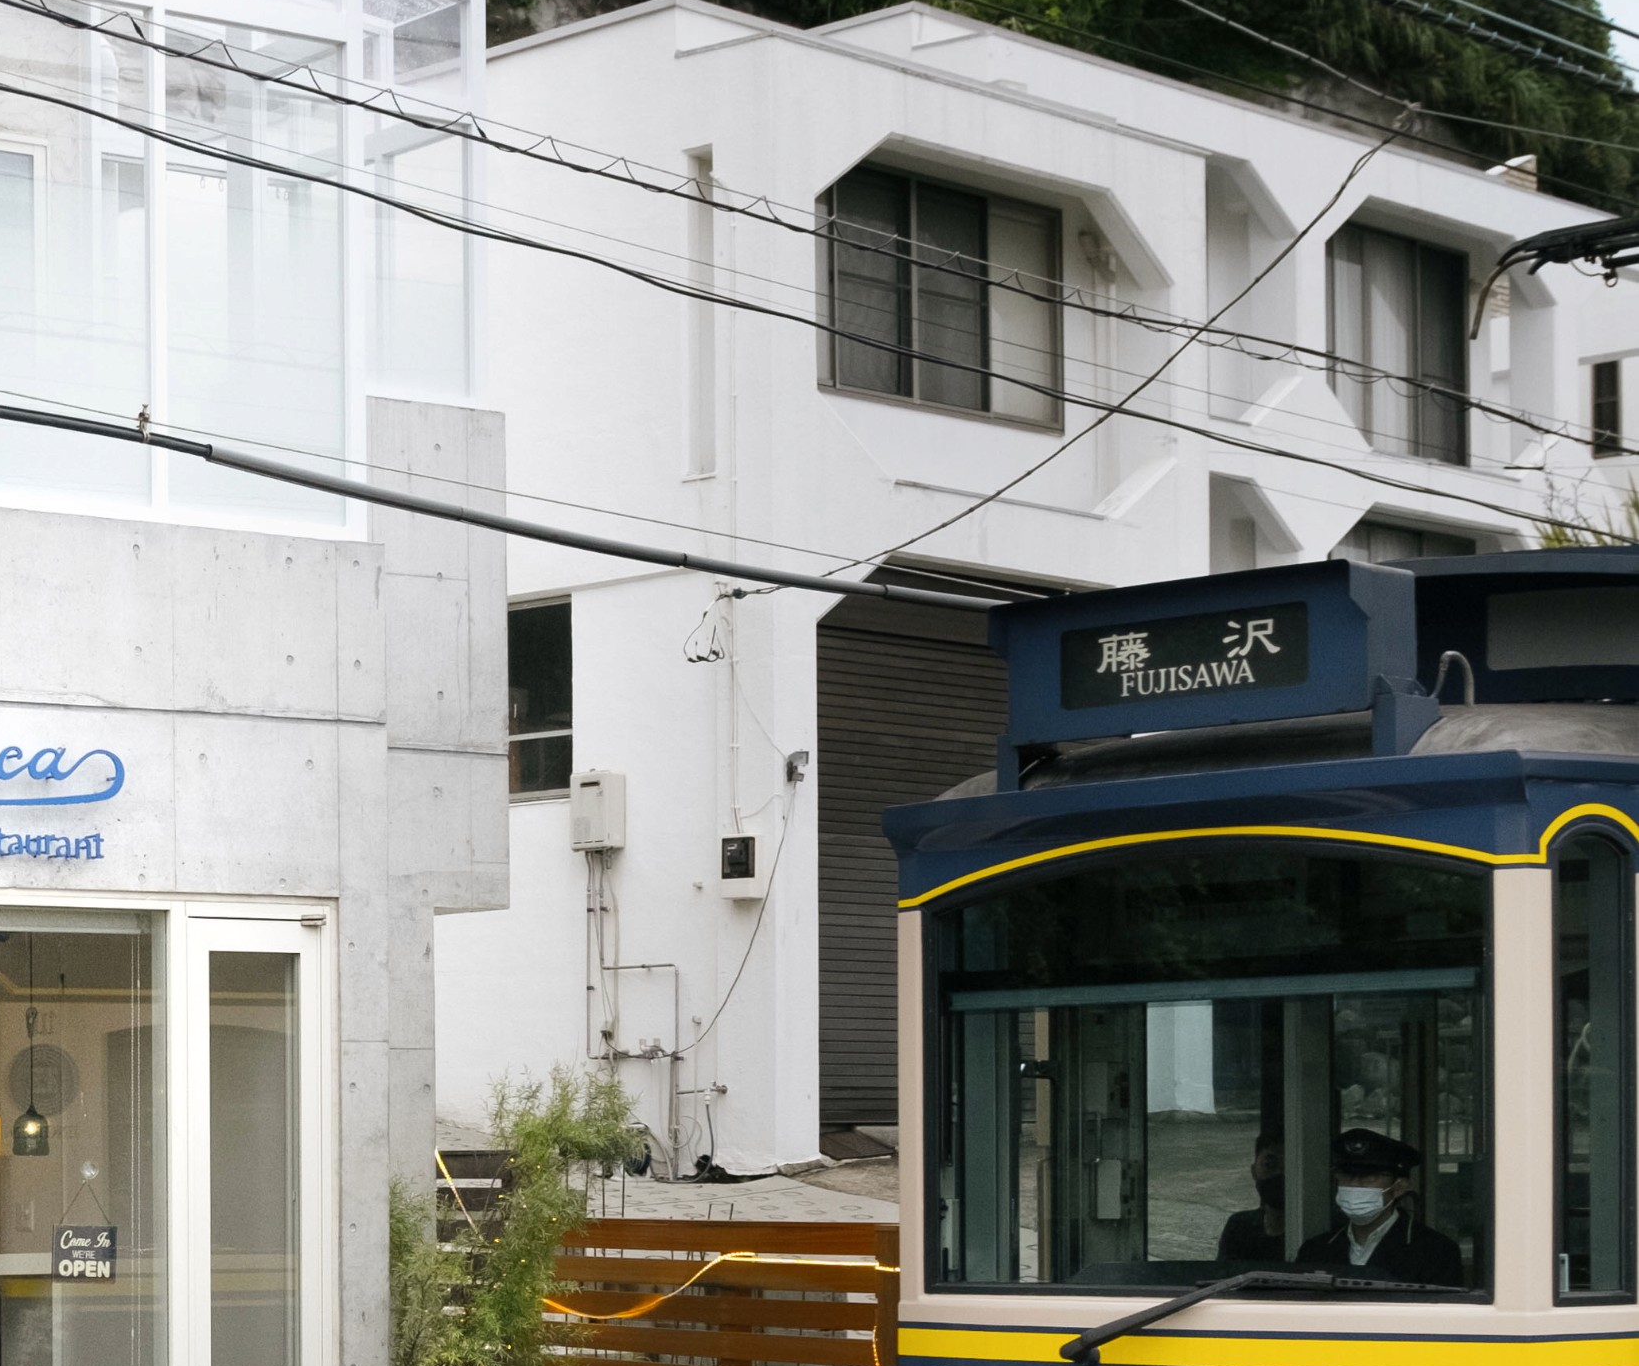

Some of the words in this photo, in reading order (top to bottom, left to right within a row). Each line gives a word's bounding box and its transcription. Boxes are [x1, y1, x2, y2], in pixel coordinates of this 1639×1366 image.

[1097, 618, 1281, 674] 藤沢
[1119, 659, 1256, 697] FUJISAWA
[60, 1230, 92, 1250] Come
[93, 1231, 112, 1248] In
[71, 1249, 96, 1260] WE'RE
[58, 1259, 111, 1279] OPEN
